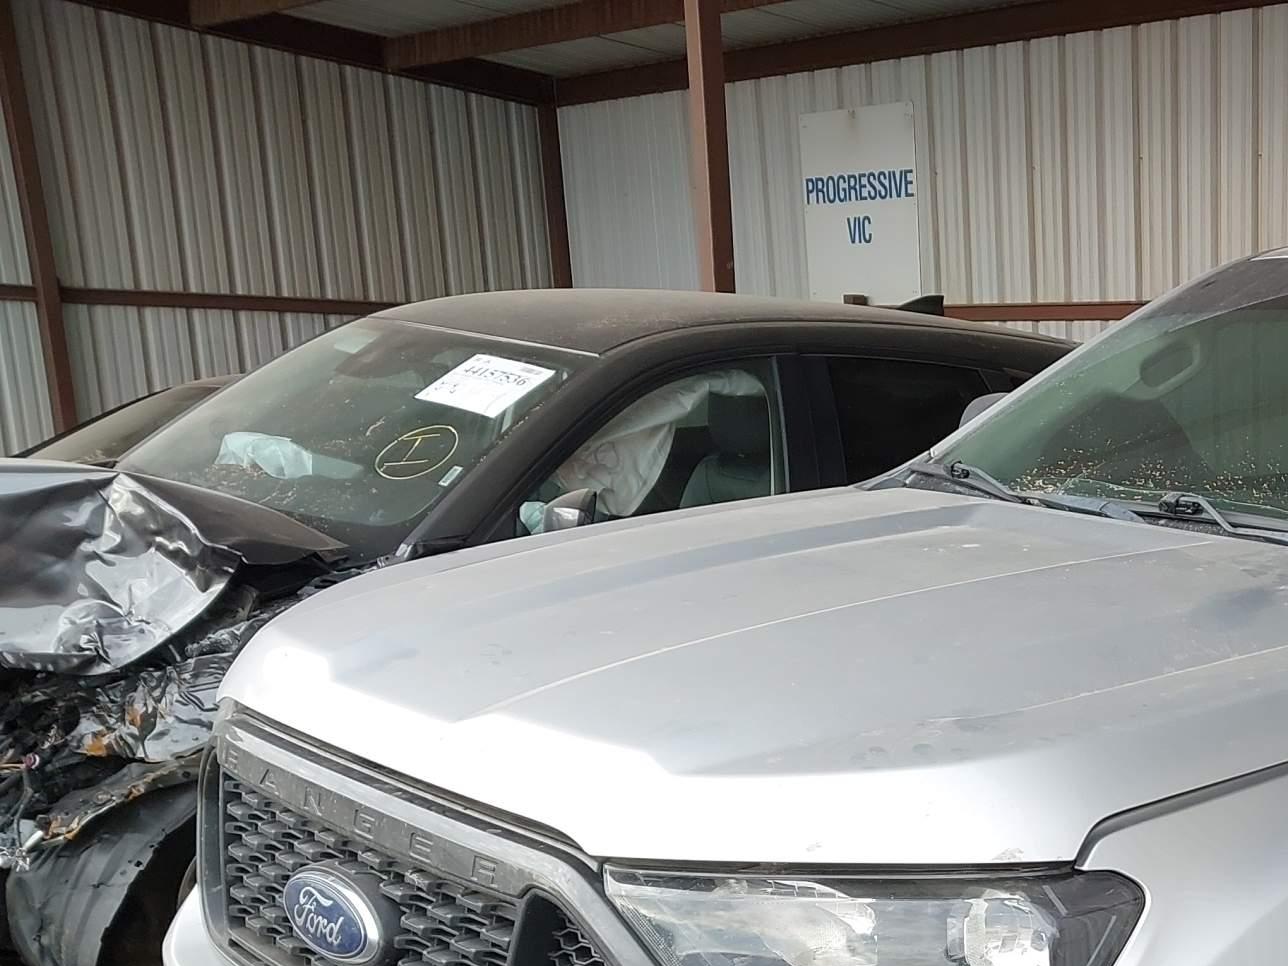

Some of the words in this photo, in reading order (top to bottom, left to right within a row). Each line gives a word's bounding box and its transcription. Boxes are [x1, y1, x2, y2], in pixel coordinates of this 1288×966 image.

[805, 168, 915, 205] PROGRESSIVE
[846, 215, 873, 244] VIC
[222, 748, 501, 888] RANGER
[294, 886, 345, 946] Ford
